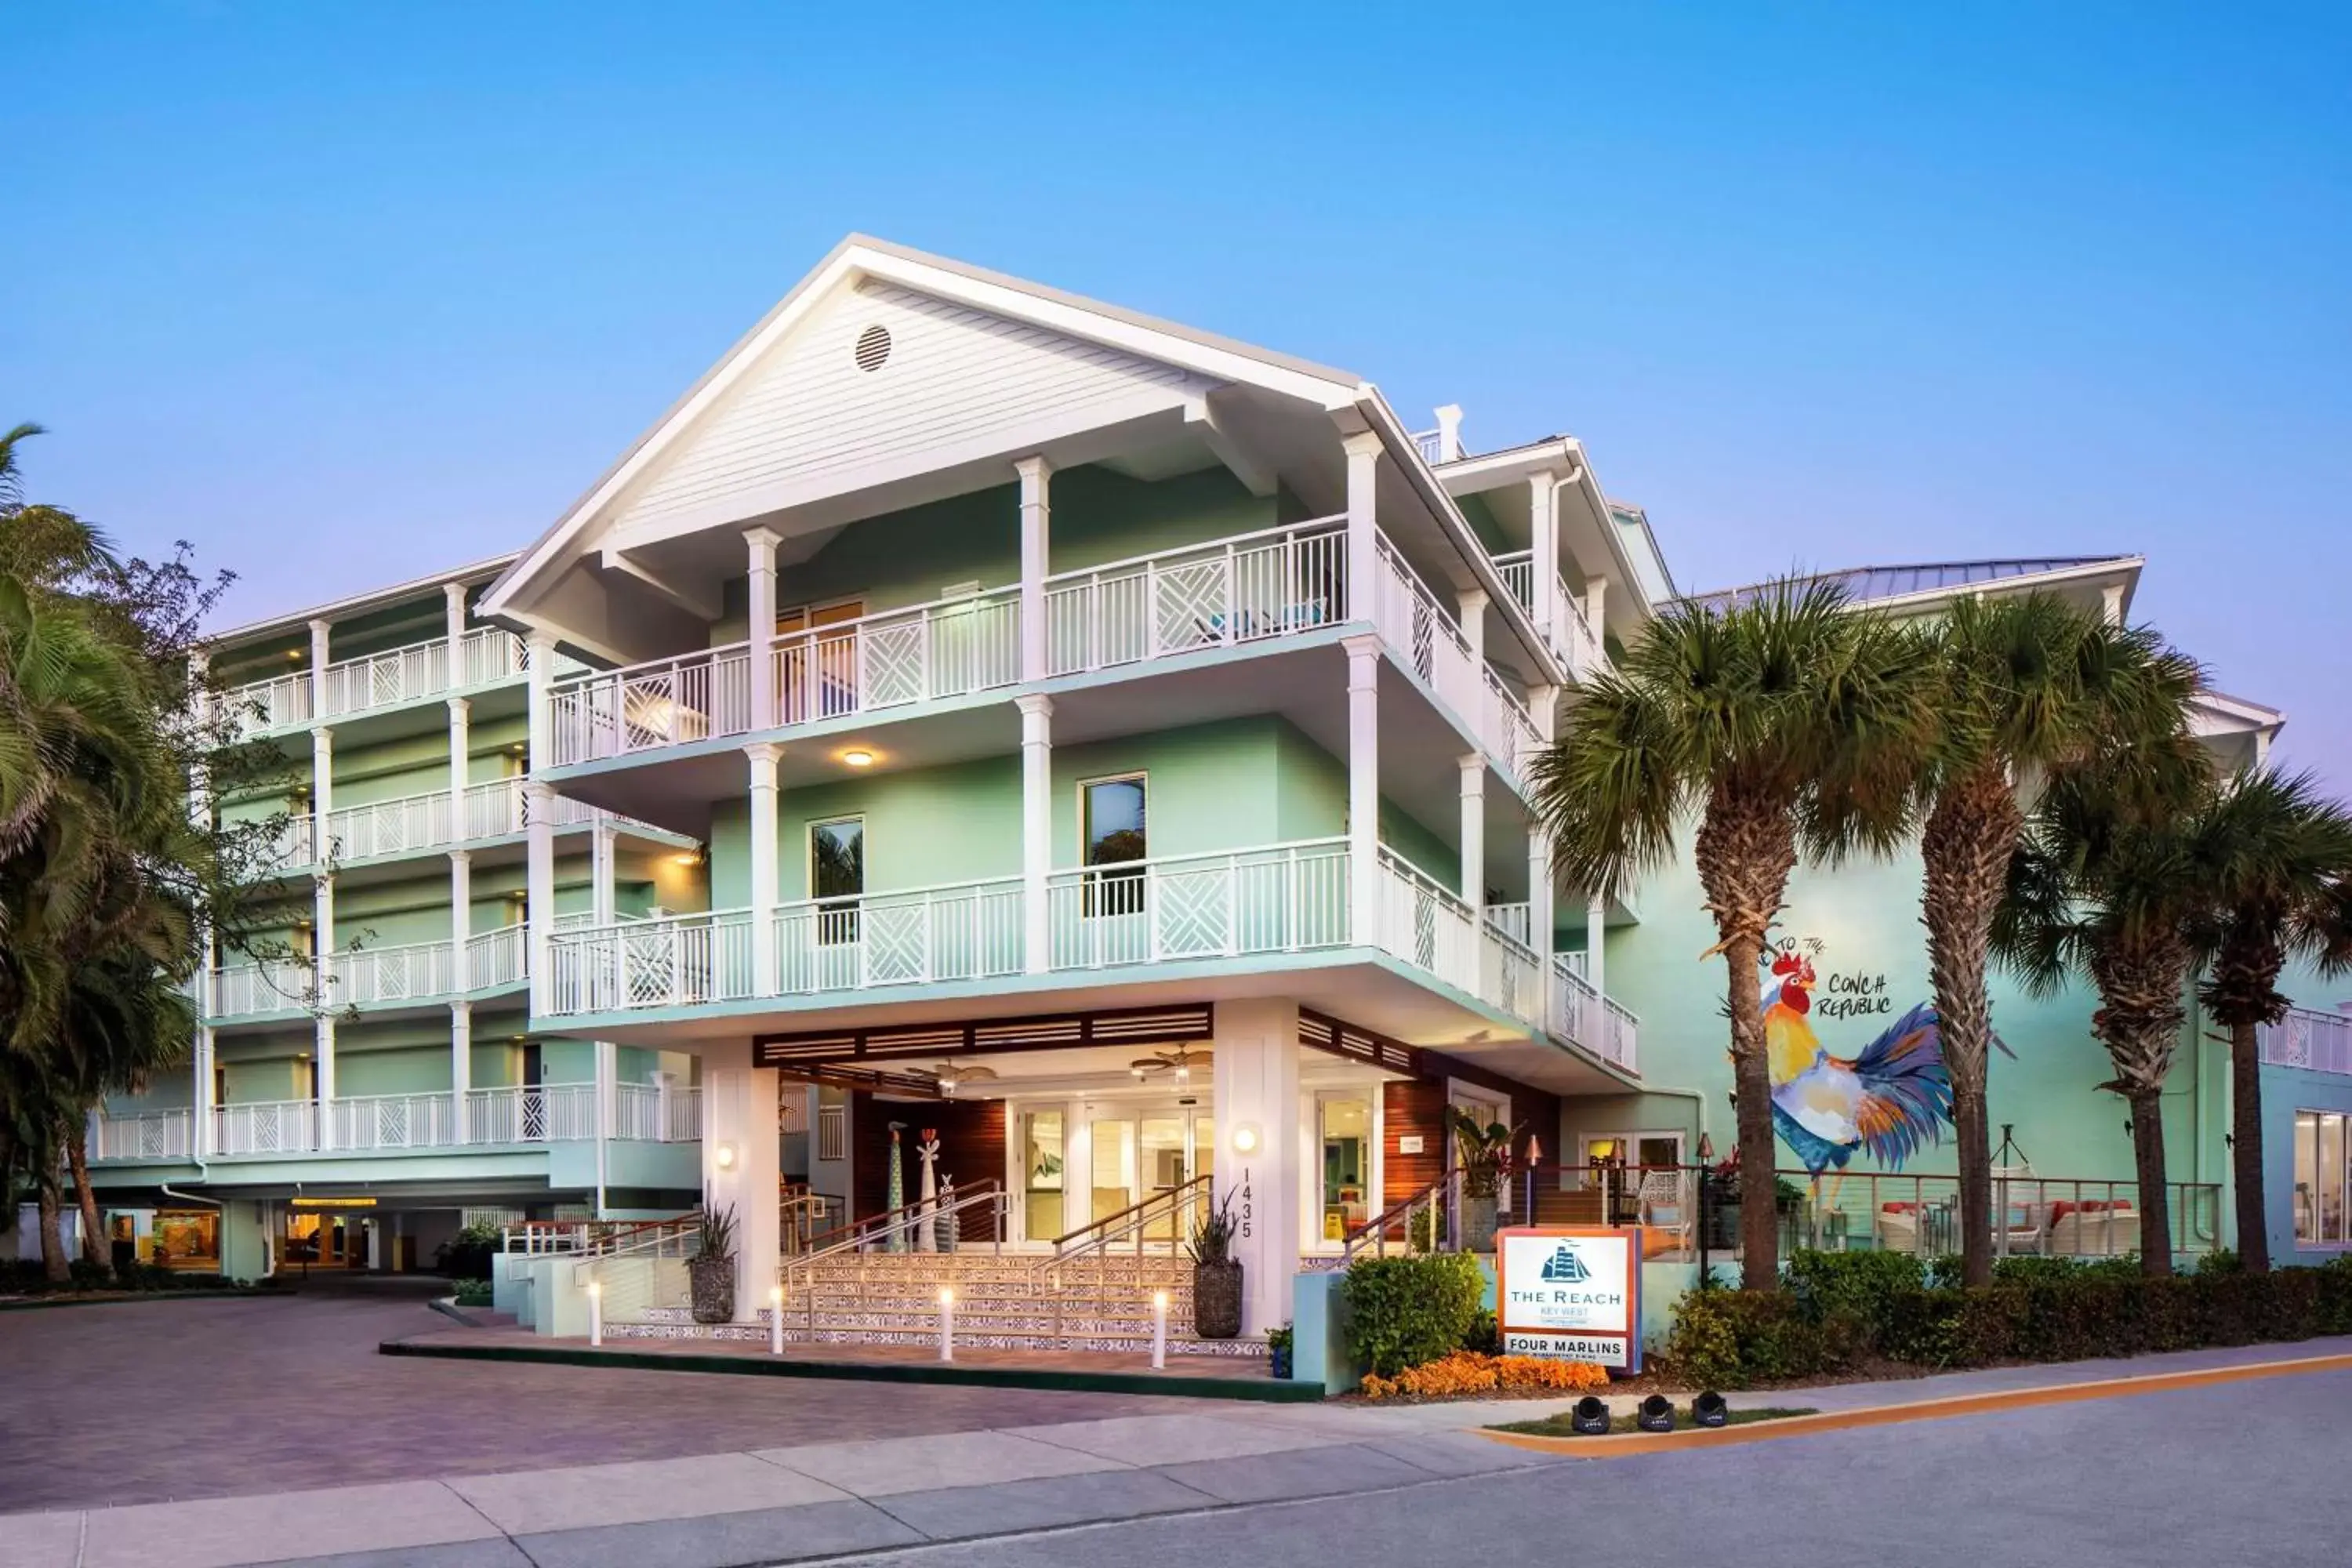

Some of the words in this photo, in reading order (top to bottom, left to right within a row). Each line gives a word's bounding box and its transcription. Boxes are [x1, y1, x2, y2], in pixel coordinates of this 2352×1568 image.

[1775, 936, 1796, 951] TO
[1803, 937, 1826, 954] THE
[1829, 970, 1886, 995] CONCH
[1815, 996, 1893, 1021] REPUBLIC
[1243, 1167, 1251, 1238] 1435
[1512, 1291, 1545, 1303] THE
[1541, 1306, 1559, 1316] KEY
[1561, 1306, 1588, 1317] WEST
[1510, 1338, 1548, 1351] FOUR
[1555, 1341, 1621, 1354] MARLINS
